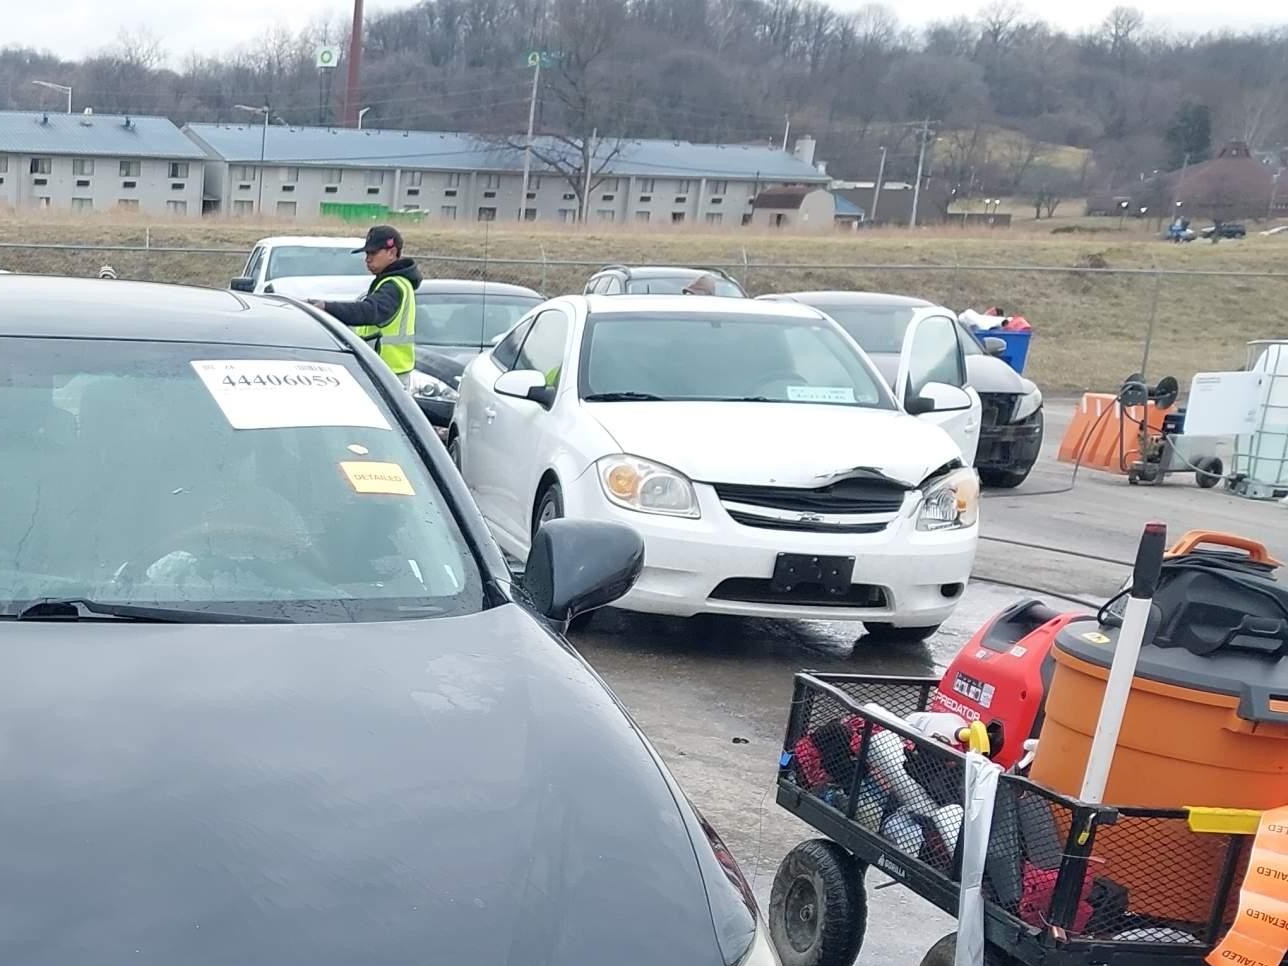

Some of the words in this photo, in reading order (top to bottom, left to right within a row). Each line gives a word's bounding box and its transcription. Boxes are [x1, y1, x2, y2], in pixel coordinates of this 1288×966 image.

[222, 374, 341, 387] 44406059
[353, 474, 402, 482] DETAILED
[934, 691, 981, 720] PREDATOR
[1256, 866, 1288, 882] AILED
